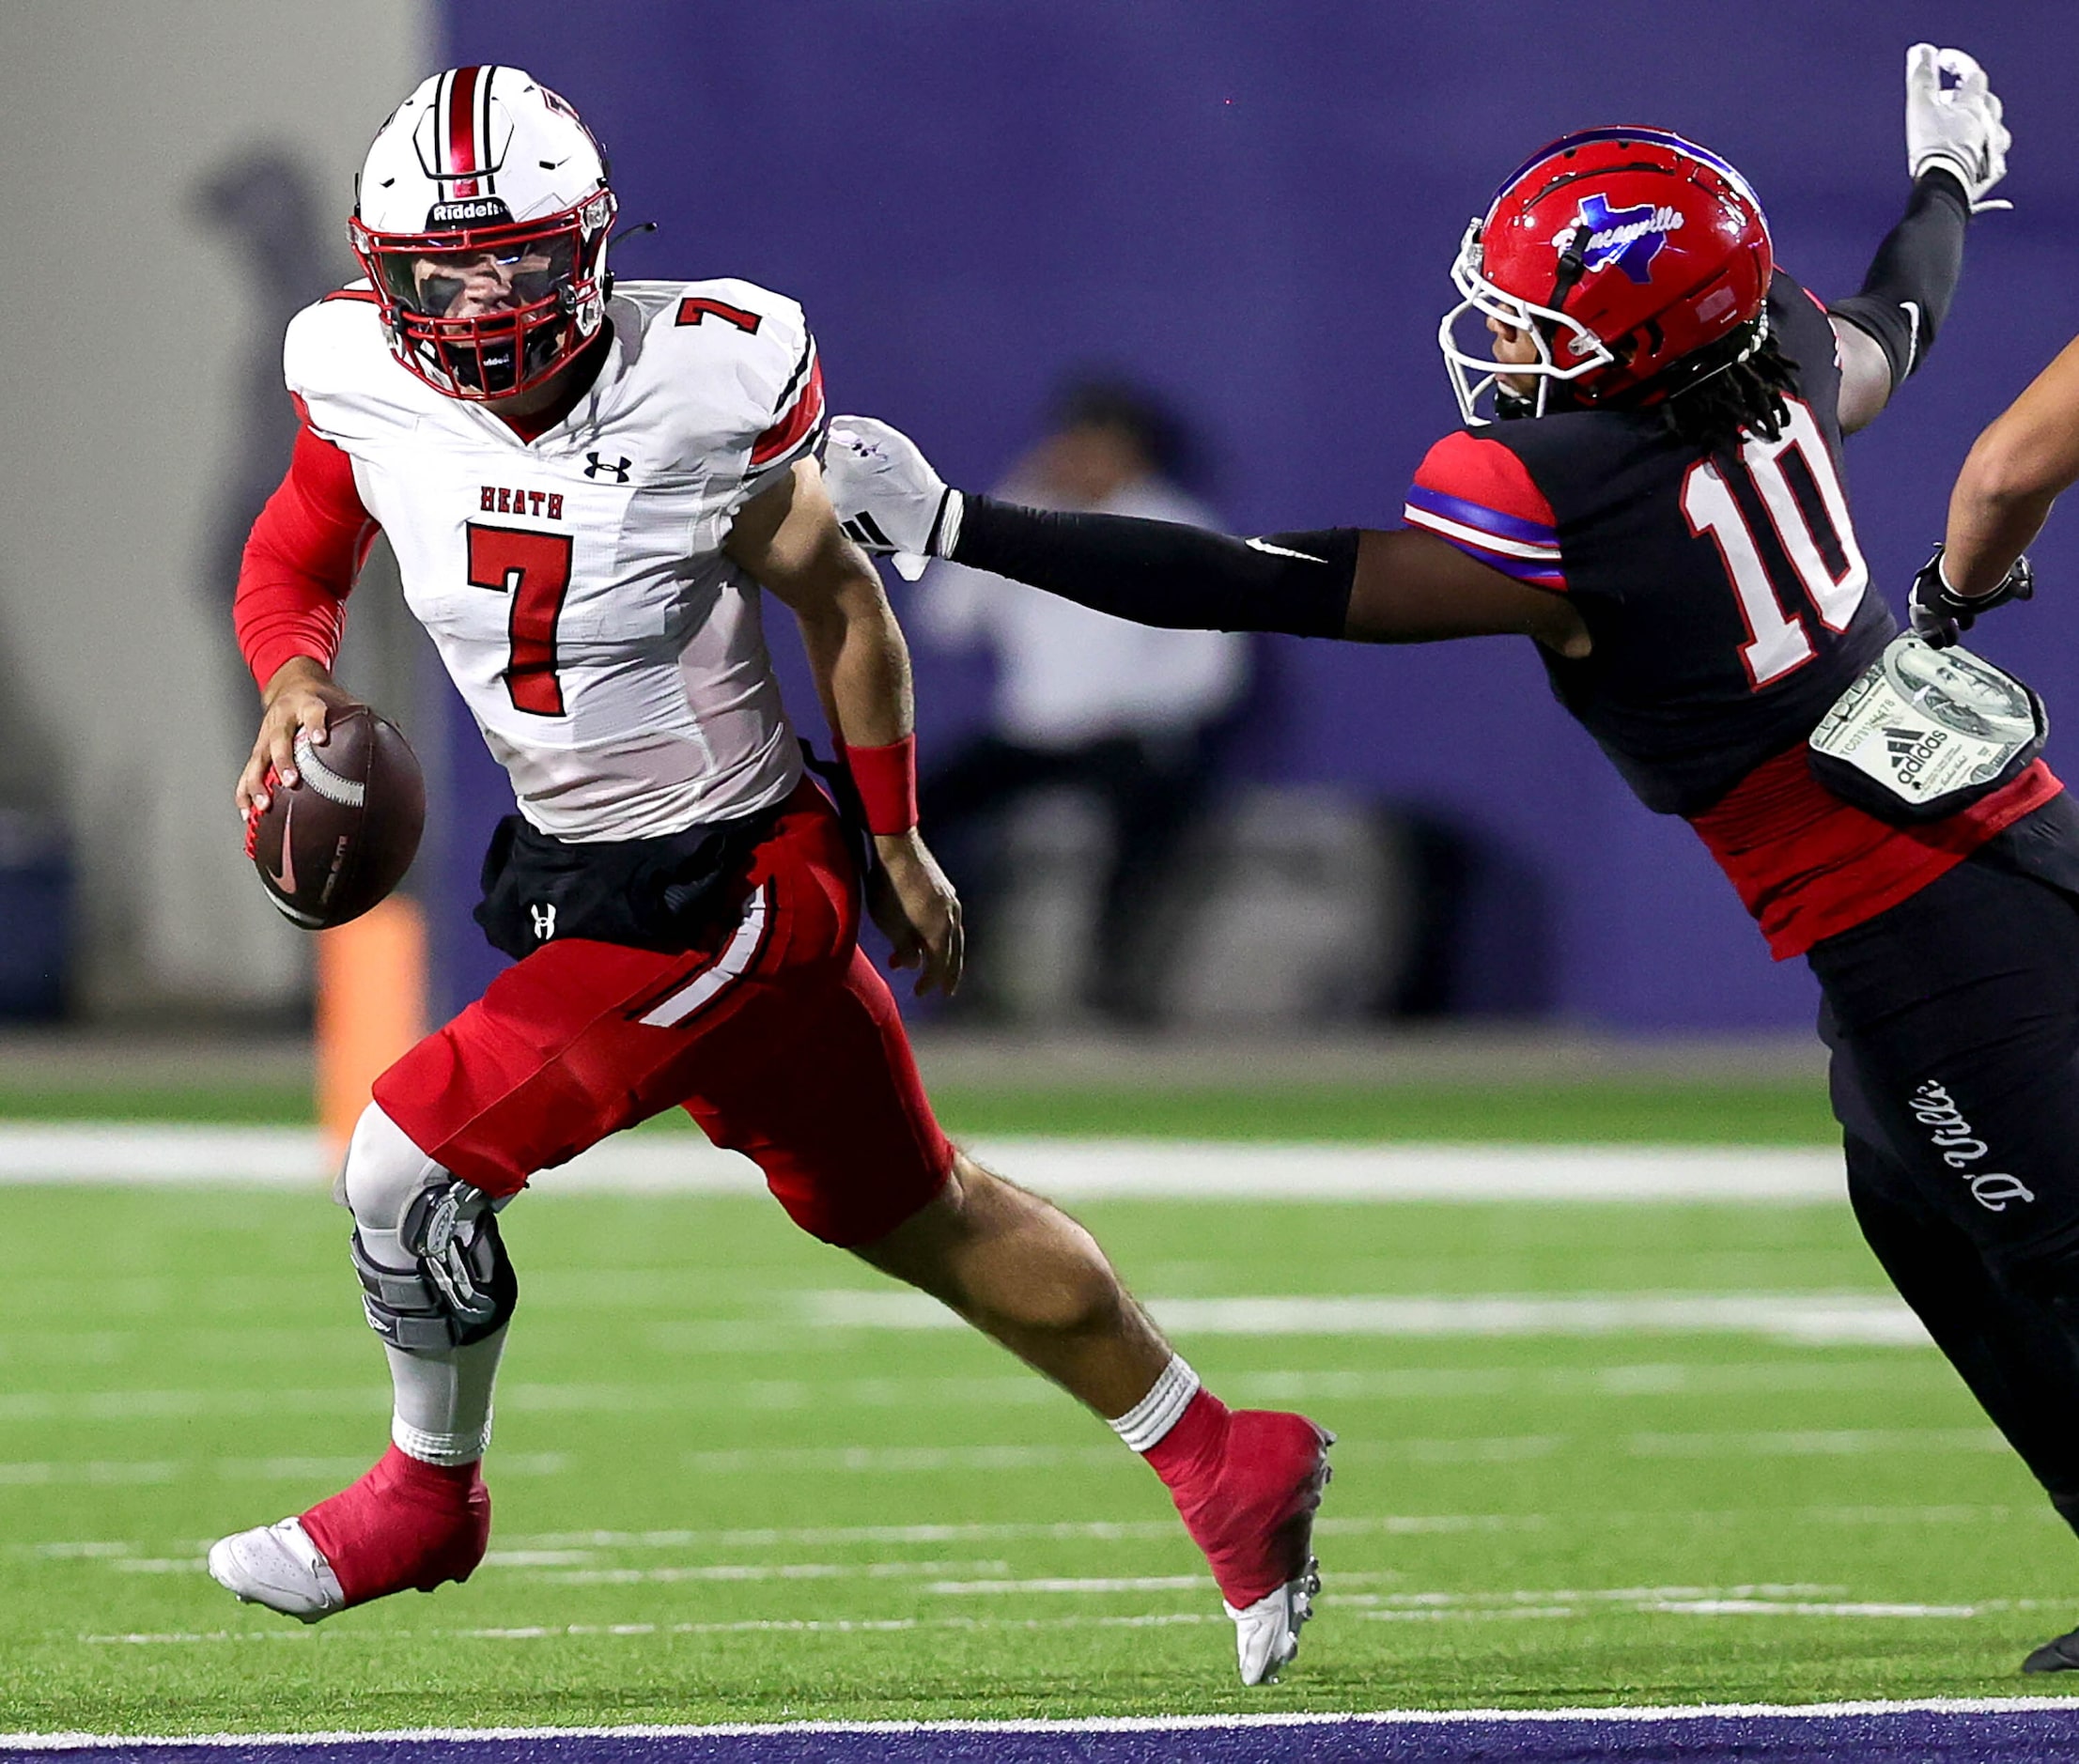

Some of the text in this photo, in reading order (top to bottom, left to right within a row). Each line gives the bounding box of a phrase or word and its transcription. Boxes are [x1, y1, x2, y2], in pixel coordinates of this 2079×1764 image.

[433, 202, 500, 221] Riddell
[675, 297, 764, 336] 7
[480, 486, 564, 520] HEATH
[1679, 391, 1869, 693] 10
[466, 520, 574, 718] 7
[1898, 730, 1947, 784] adidas
